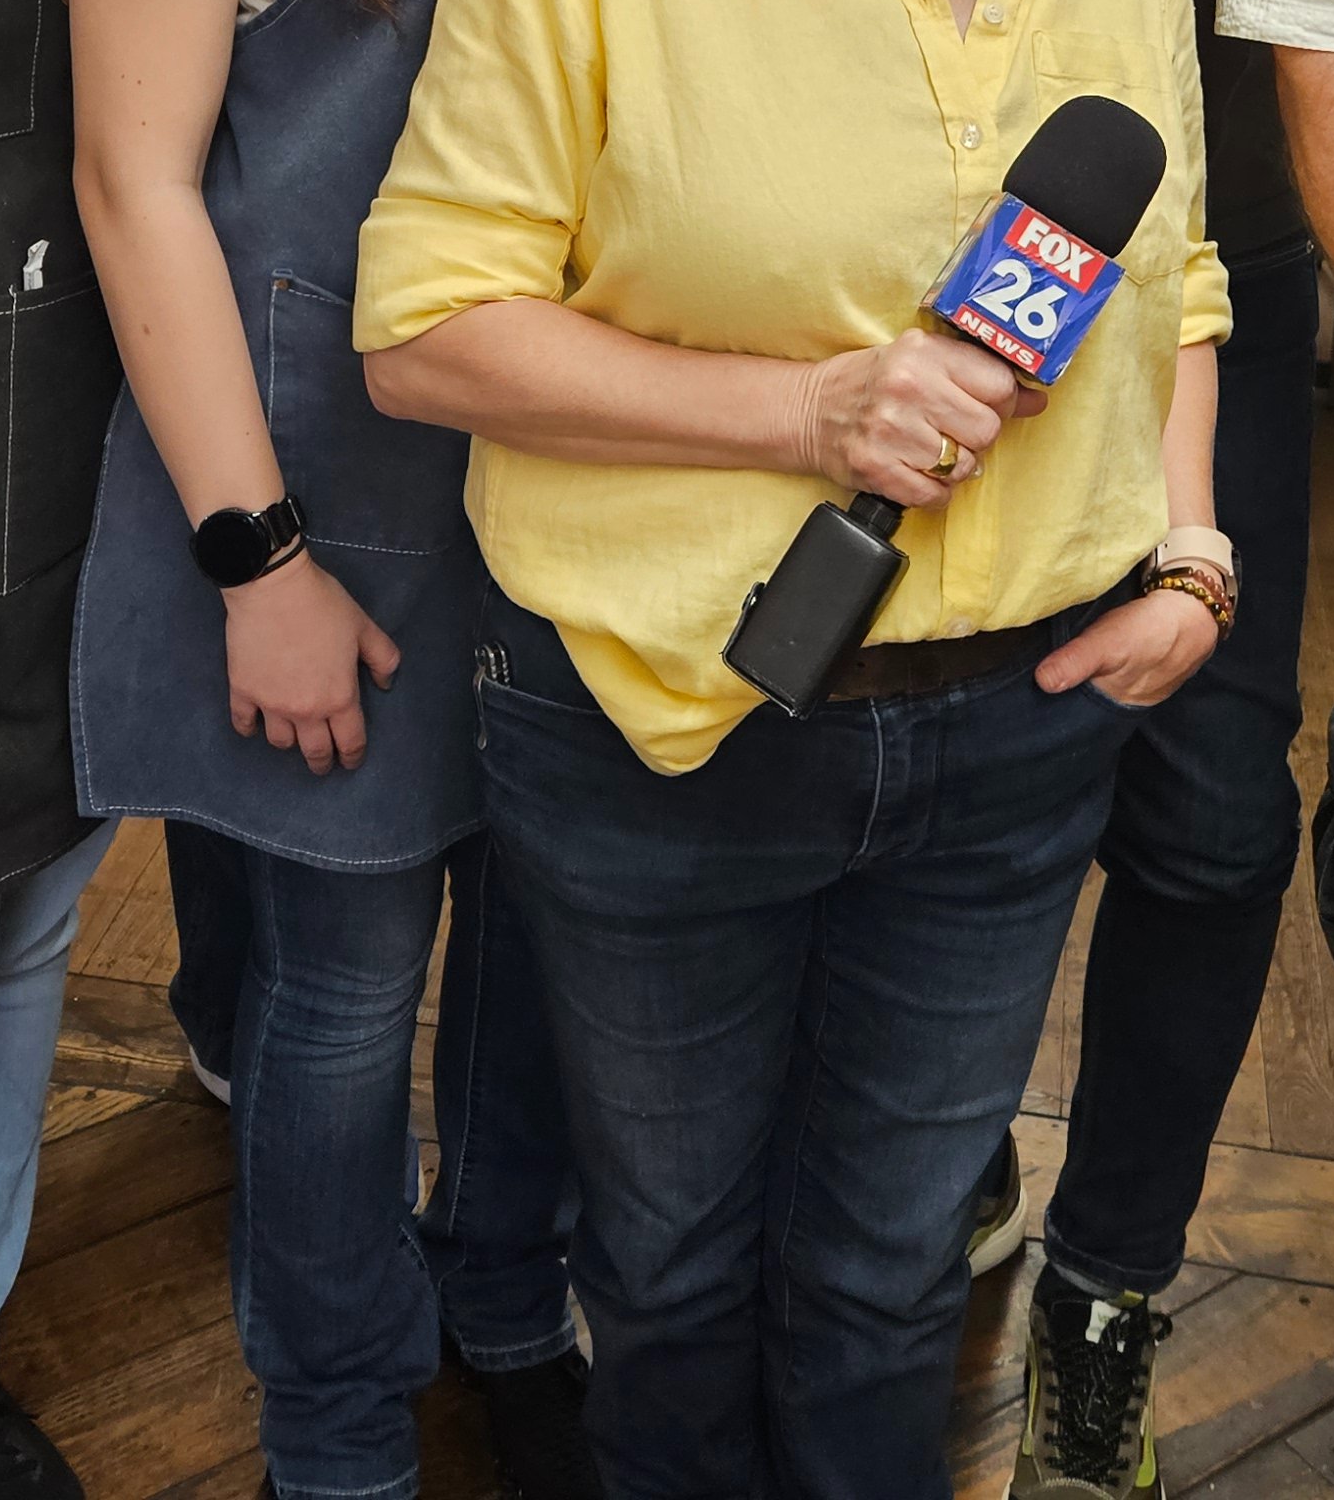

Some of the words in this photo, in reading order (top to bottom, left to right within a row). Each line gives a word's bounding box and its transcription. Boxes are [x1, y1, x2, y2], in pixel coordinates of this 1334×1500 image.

[1017, 216, 1095, 283] FOX
[972, 258, 1068, 340] 26
[959, 310, 1036, 366] NEWS
